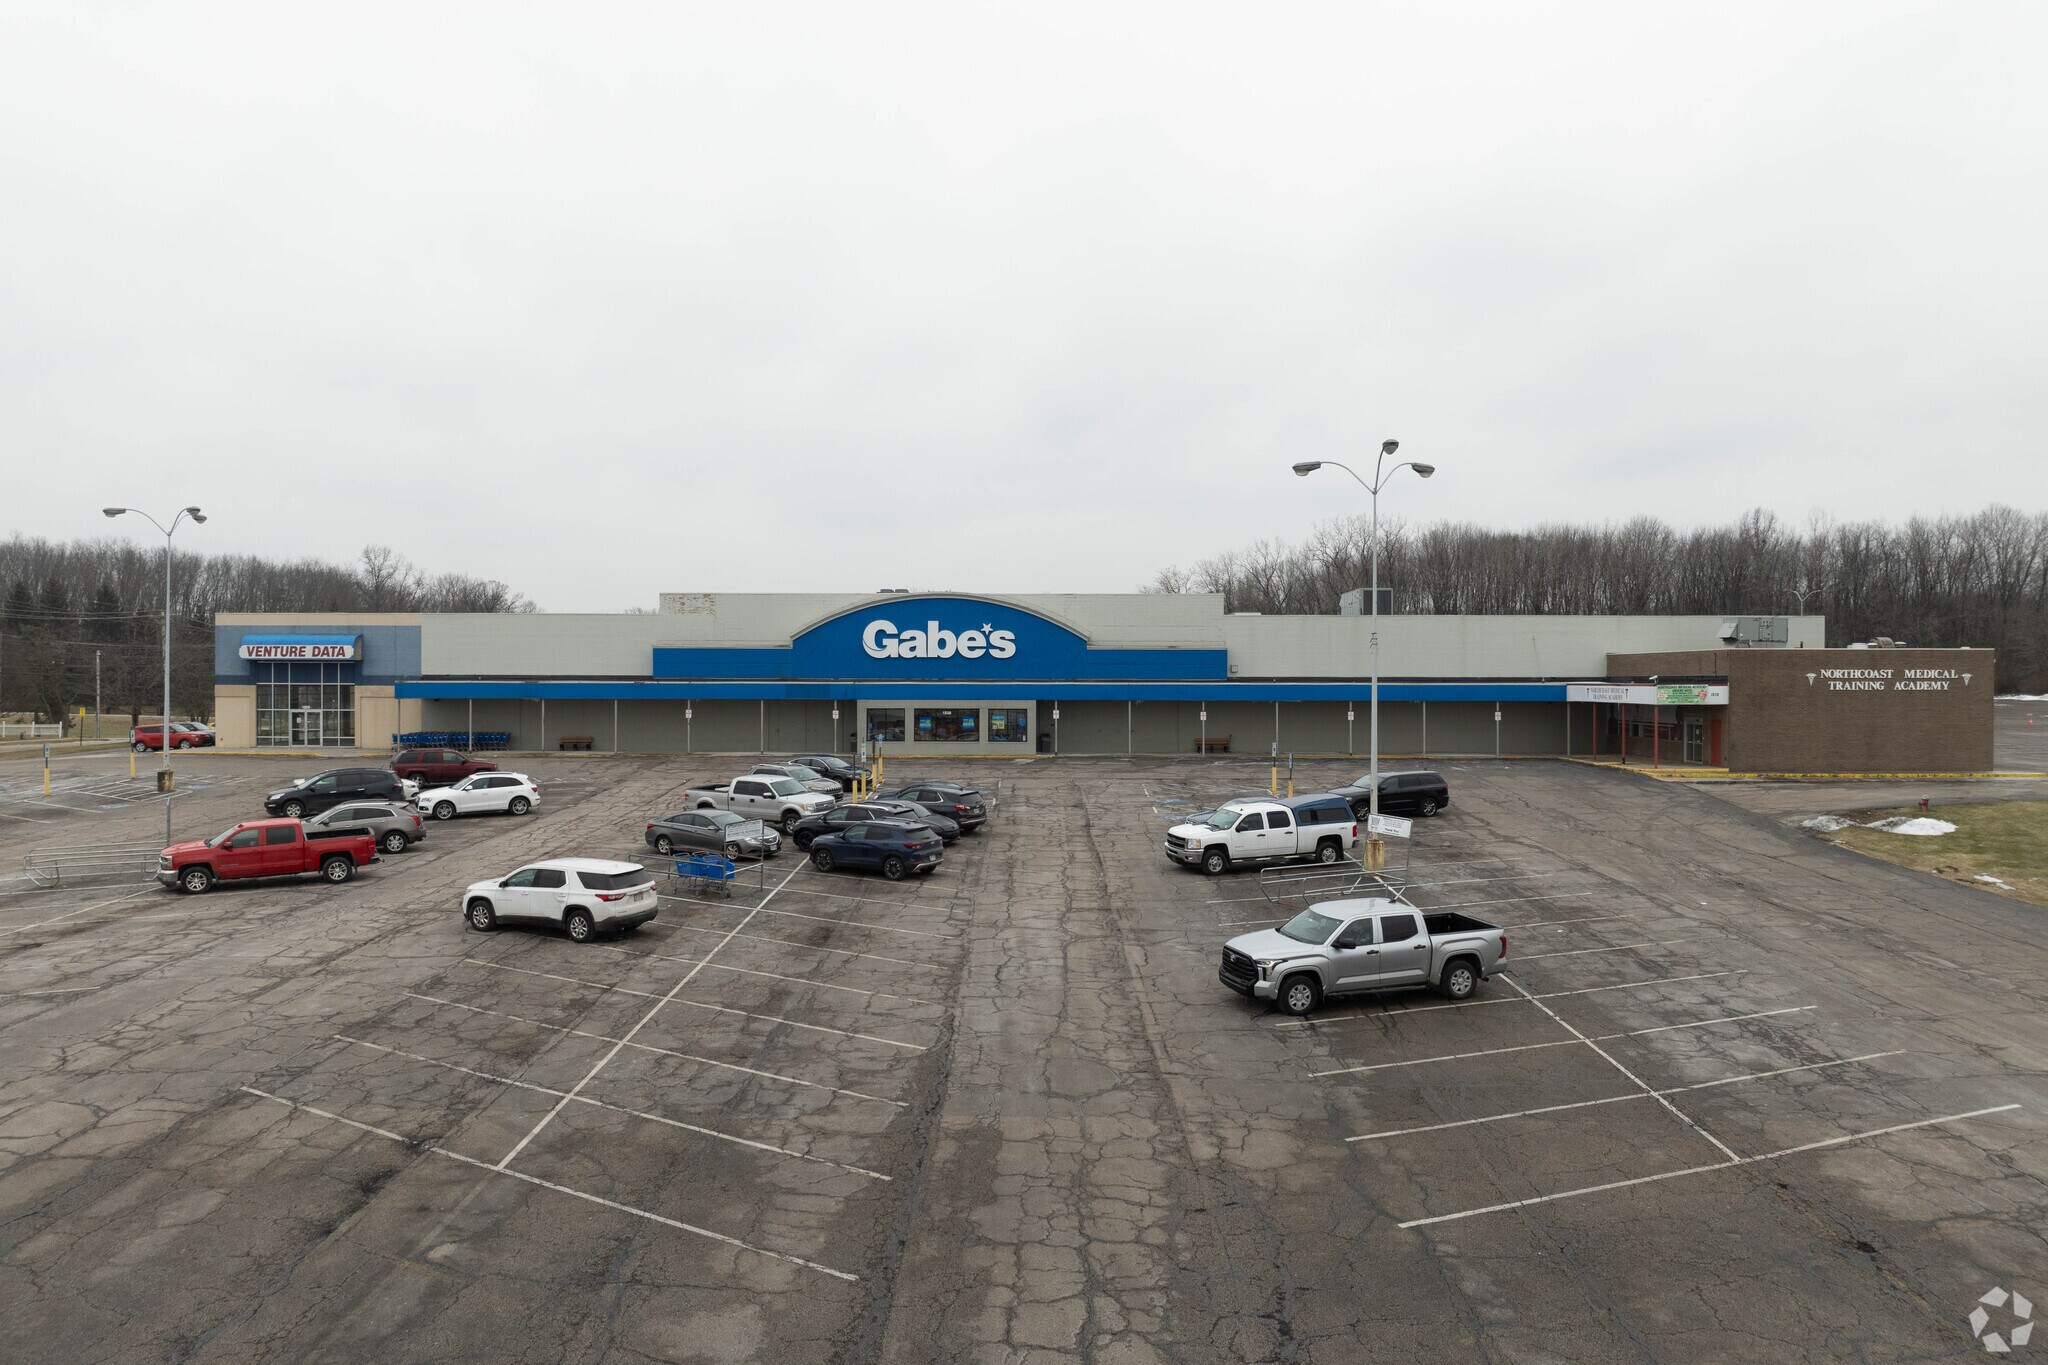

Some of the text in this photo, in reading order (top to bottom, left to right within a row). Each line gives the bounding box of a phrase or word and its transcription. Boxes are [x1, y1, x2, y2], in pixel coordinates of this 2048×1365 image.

[862, 619, 1017, 659] Gabe's
[246, 646, 346, 658] VENTURE DATA
[1820, 669, 1959, 679] NORTHCOAST MEDICAL
[1828, 681, 1950, 691] TRAINING ACADEMY
